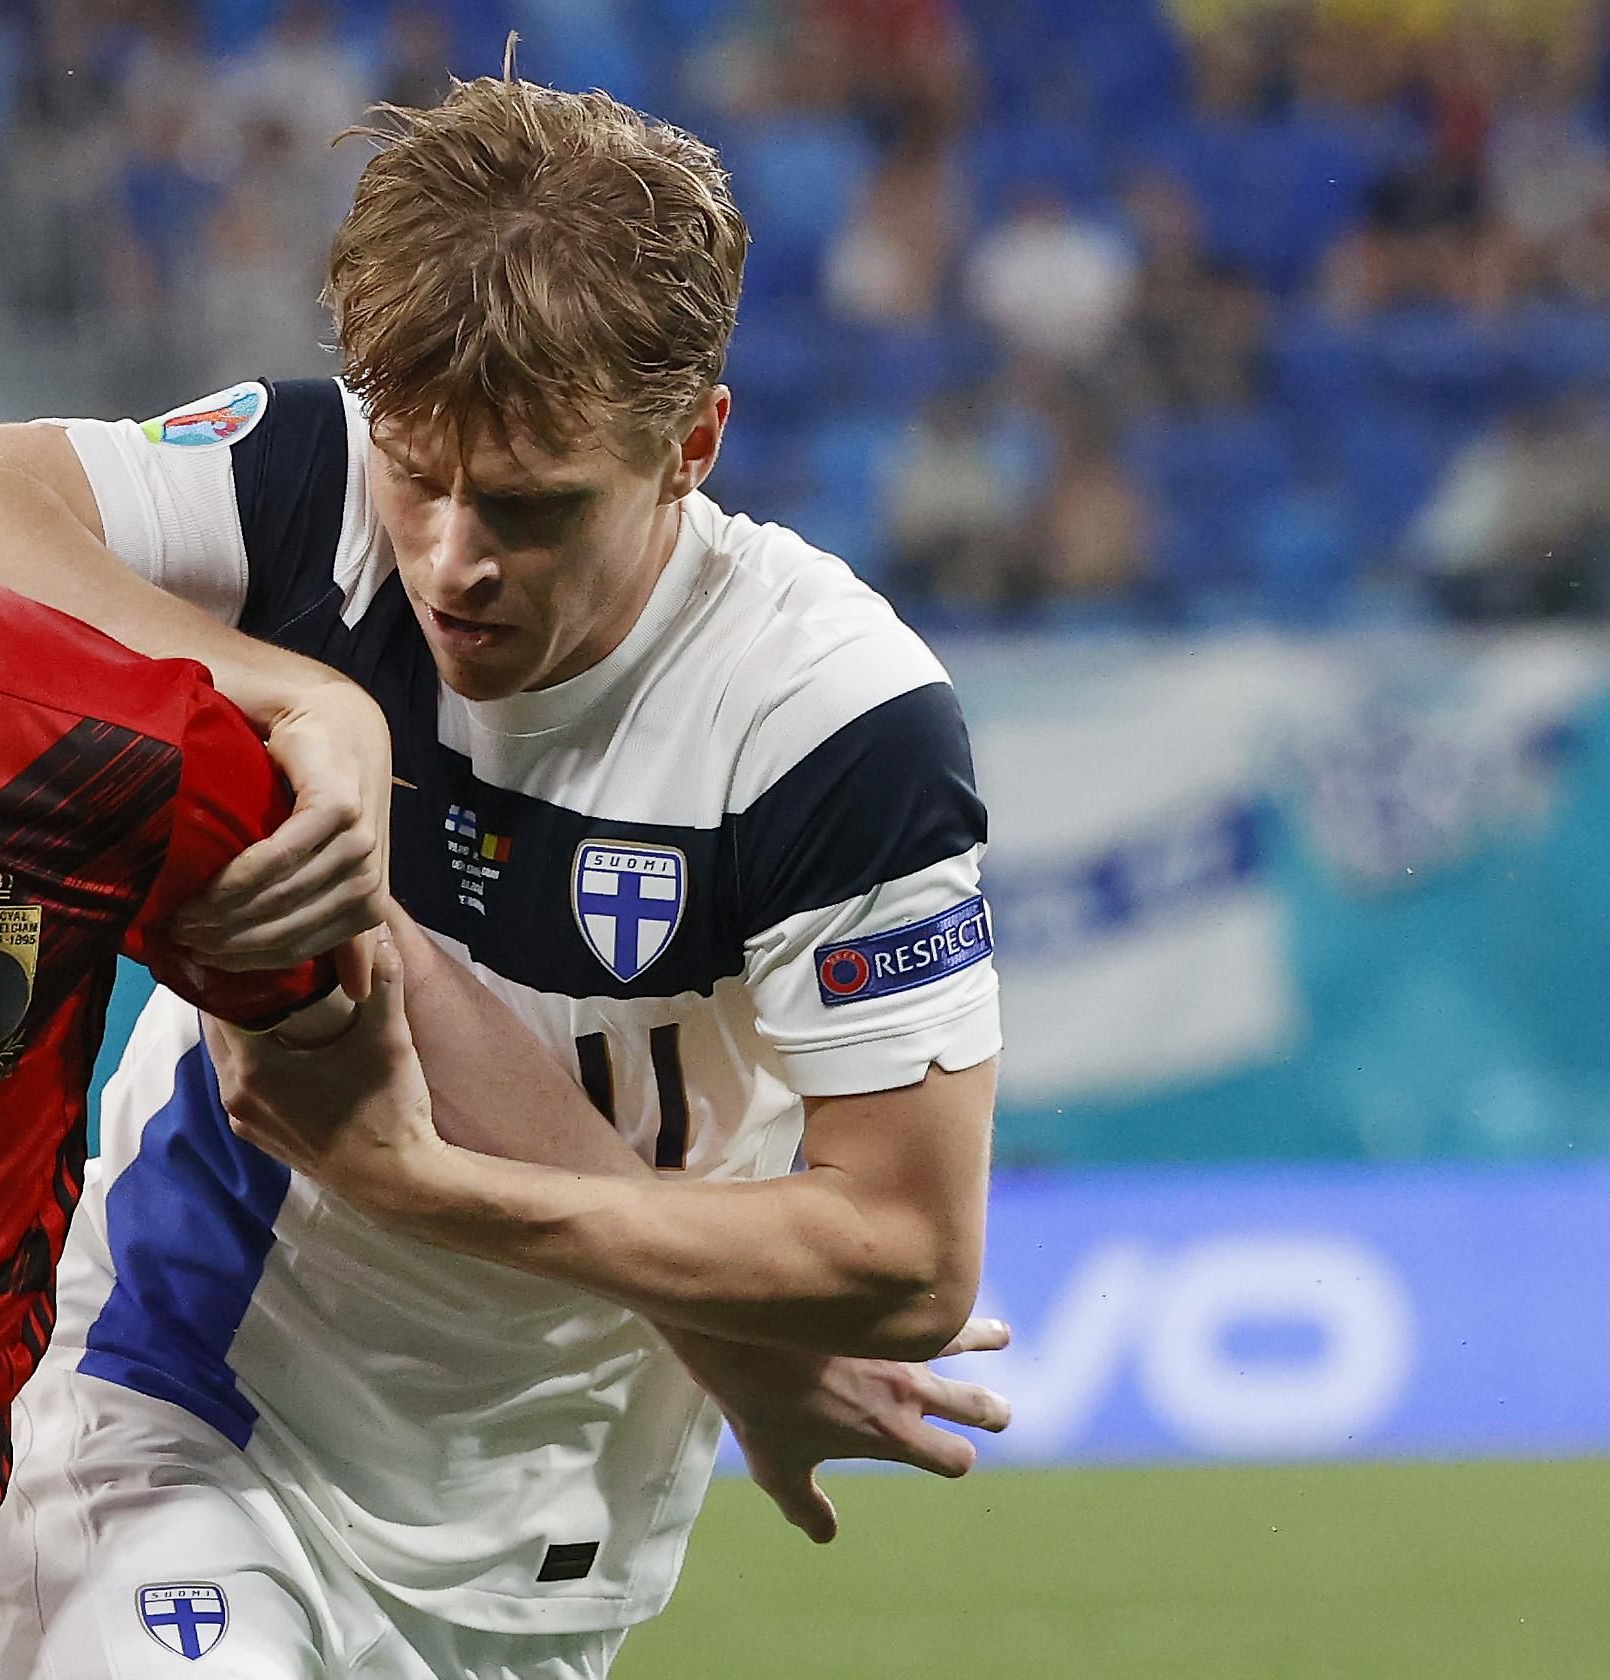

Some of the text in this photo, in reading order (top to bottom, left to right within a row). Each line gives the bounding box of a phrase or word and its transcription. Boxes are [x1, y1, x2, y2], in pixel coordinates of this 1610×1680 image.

[594, 855, 668, 872] SUOMI
[874, 912, 986, 979] RESPECT
[151, 1590, 211, 1599] SUOMI
